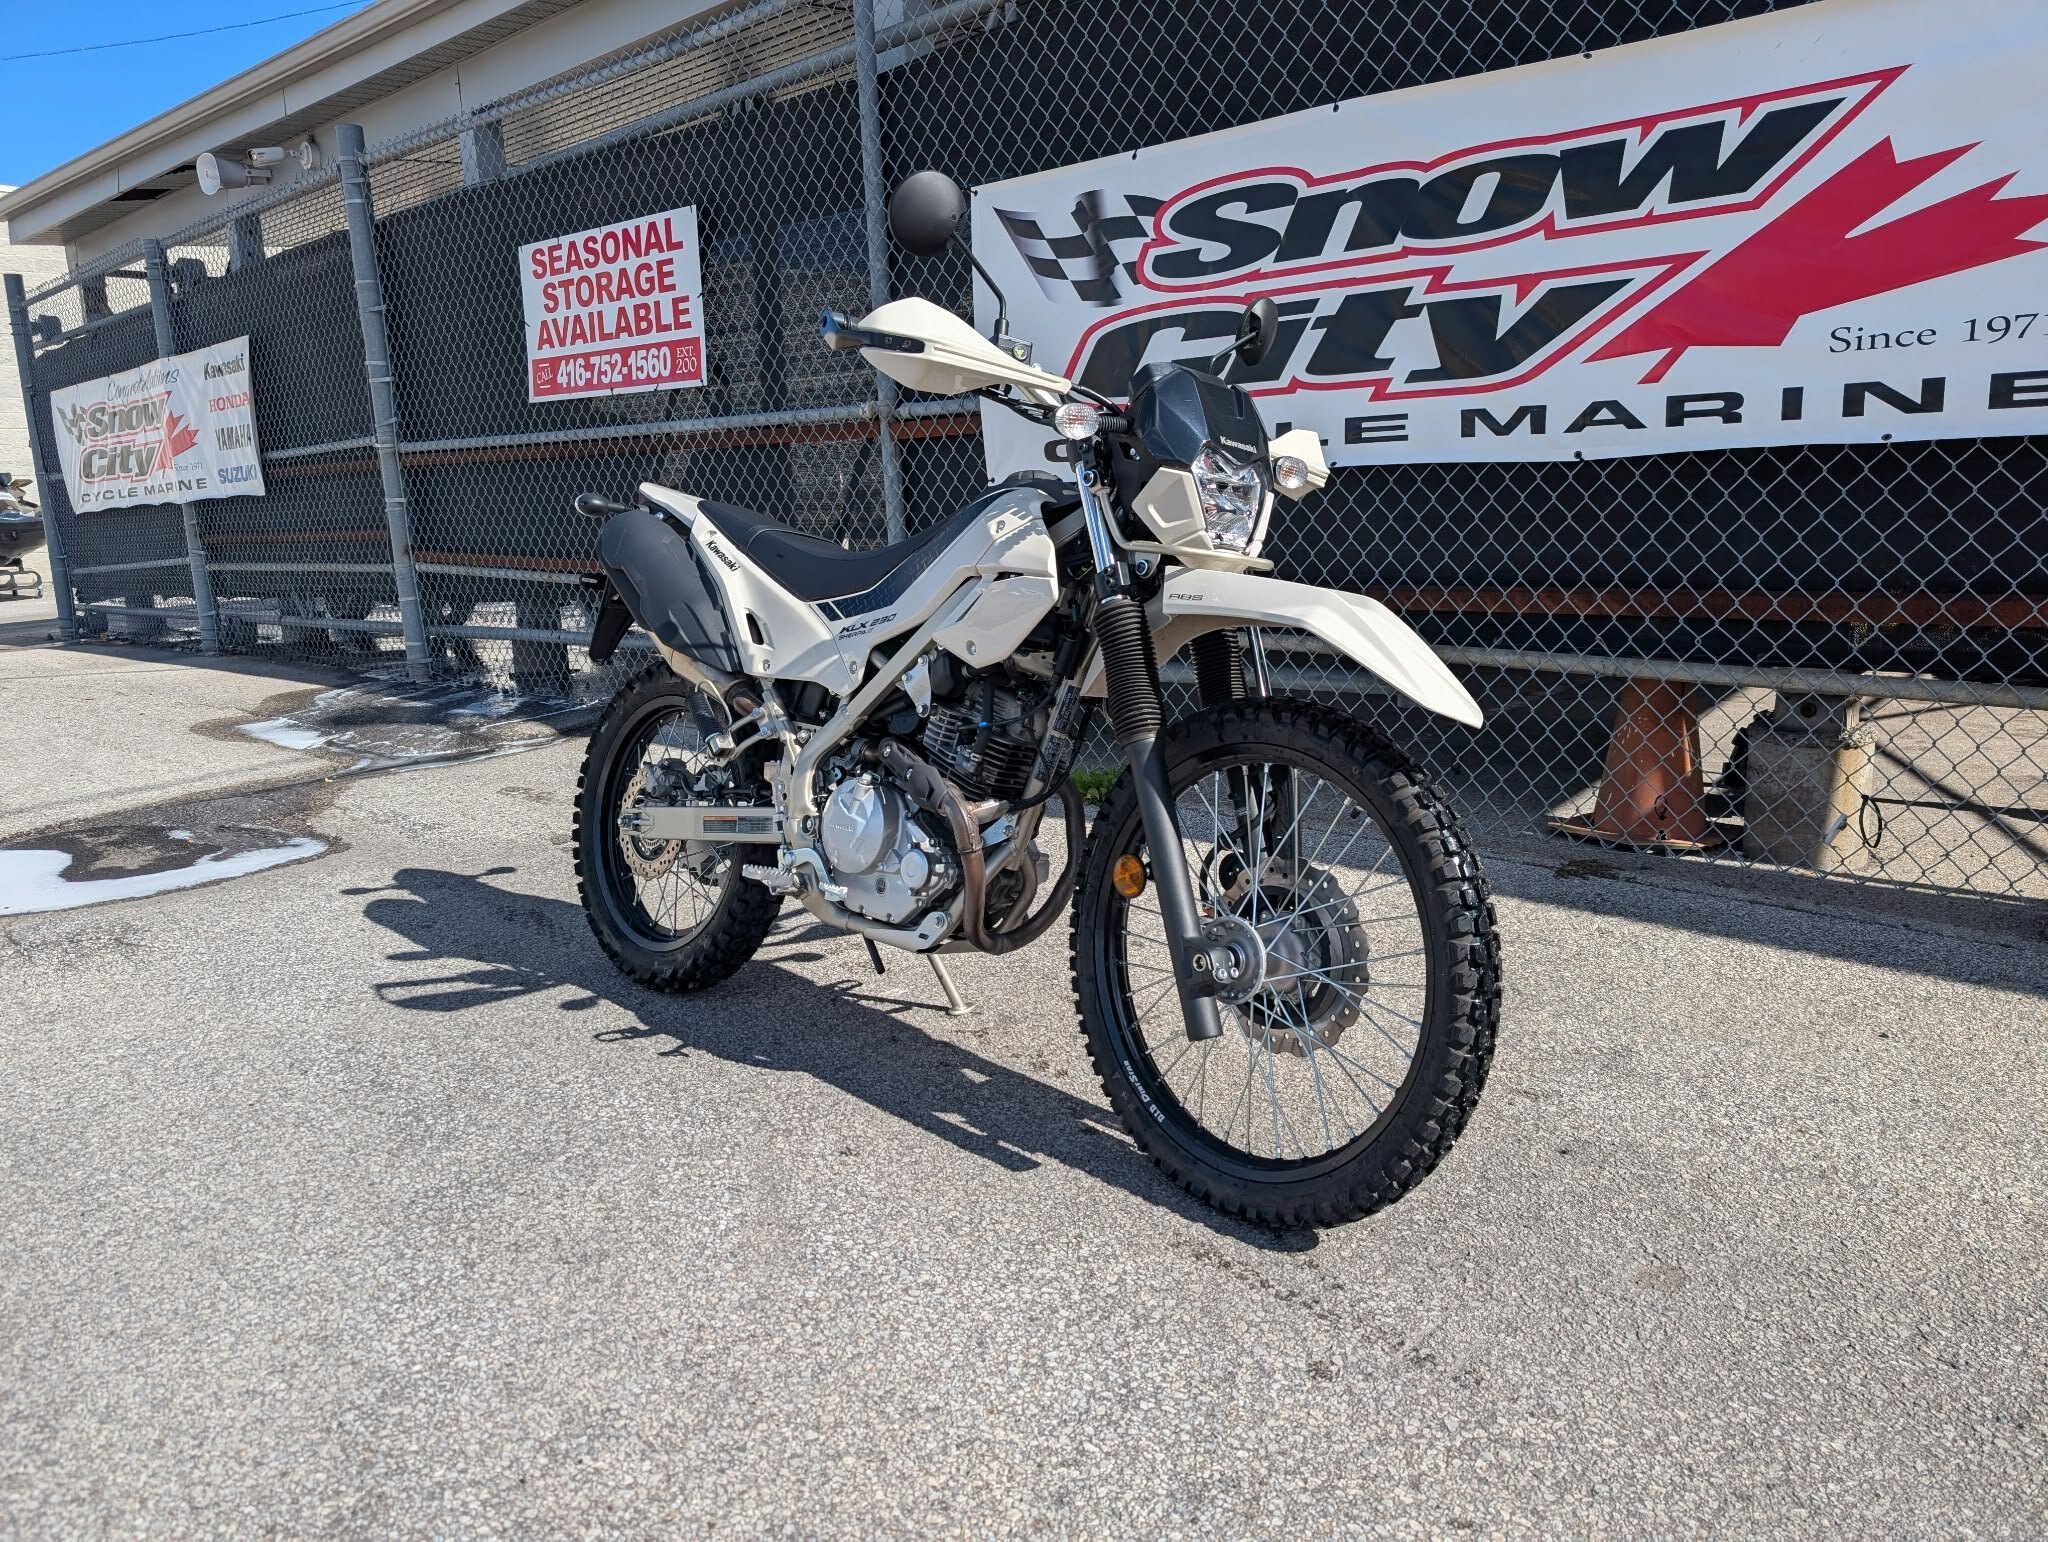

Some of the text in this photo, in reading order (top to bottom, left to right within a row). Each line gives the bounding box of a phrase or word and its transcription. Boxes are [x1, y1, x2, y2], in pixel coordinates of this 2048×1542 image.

[1151, 96, 1849, 279] Snow
[531, 217, 684, 280] SEASONAL
[542, 257, 677, 314] STORAGE
[537, 294, 692, 351] AVAILABLE
[1829, 312, 2048, 353] Since 197
[676, 345, 696, 357] EXT.
[204, 352, 246, 381] Kawasaki
[536, 345, 671, 388] CALL 416-752-1560
[676, 357, 698, 374] 200
[209, 391, 250, 413] HONDA
[1460, 369, 2048, 438] MARINE
[215, 423, 251, 451] YAMAHA
[1220, 435, 1257, 454] Kawasaki
[218, 463, 258, 485] SUZUKI
[81, 477, 208, 503] CYCLE MARINE
[706, 540, 740, 572] Kawasaki
[1168, 593, 1204, 601] ABS
[838, 612, 898, 635] KLX 230
